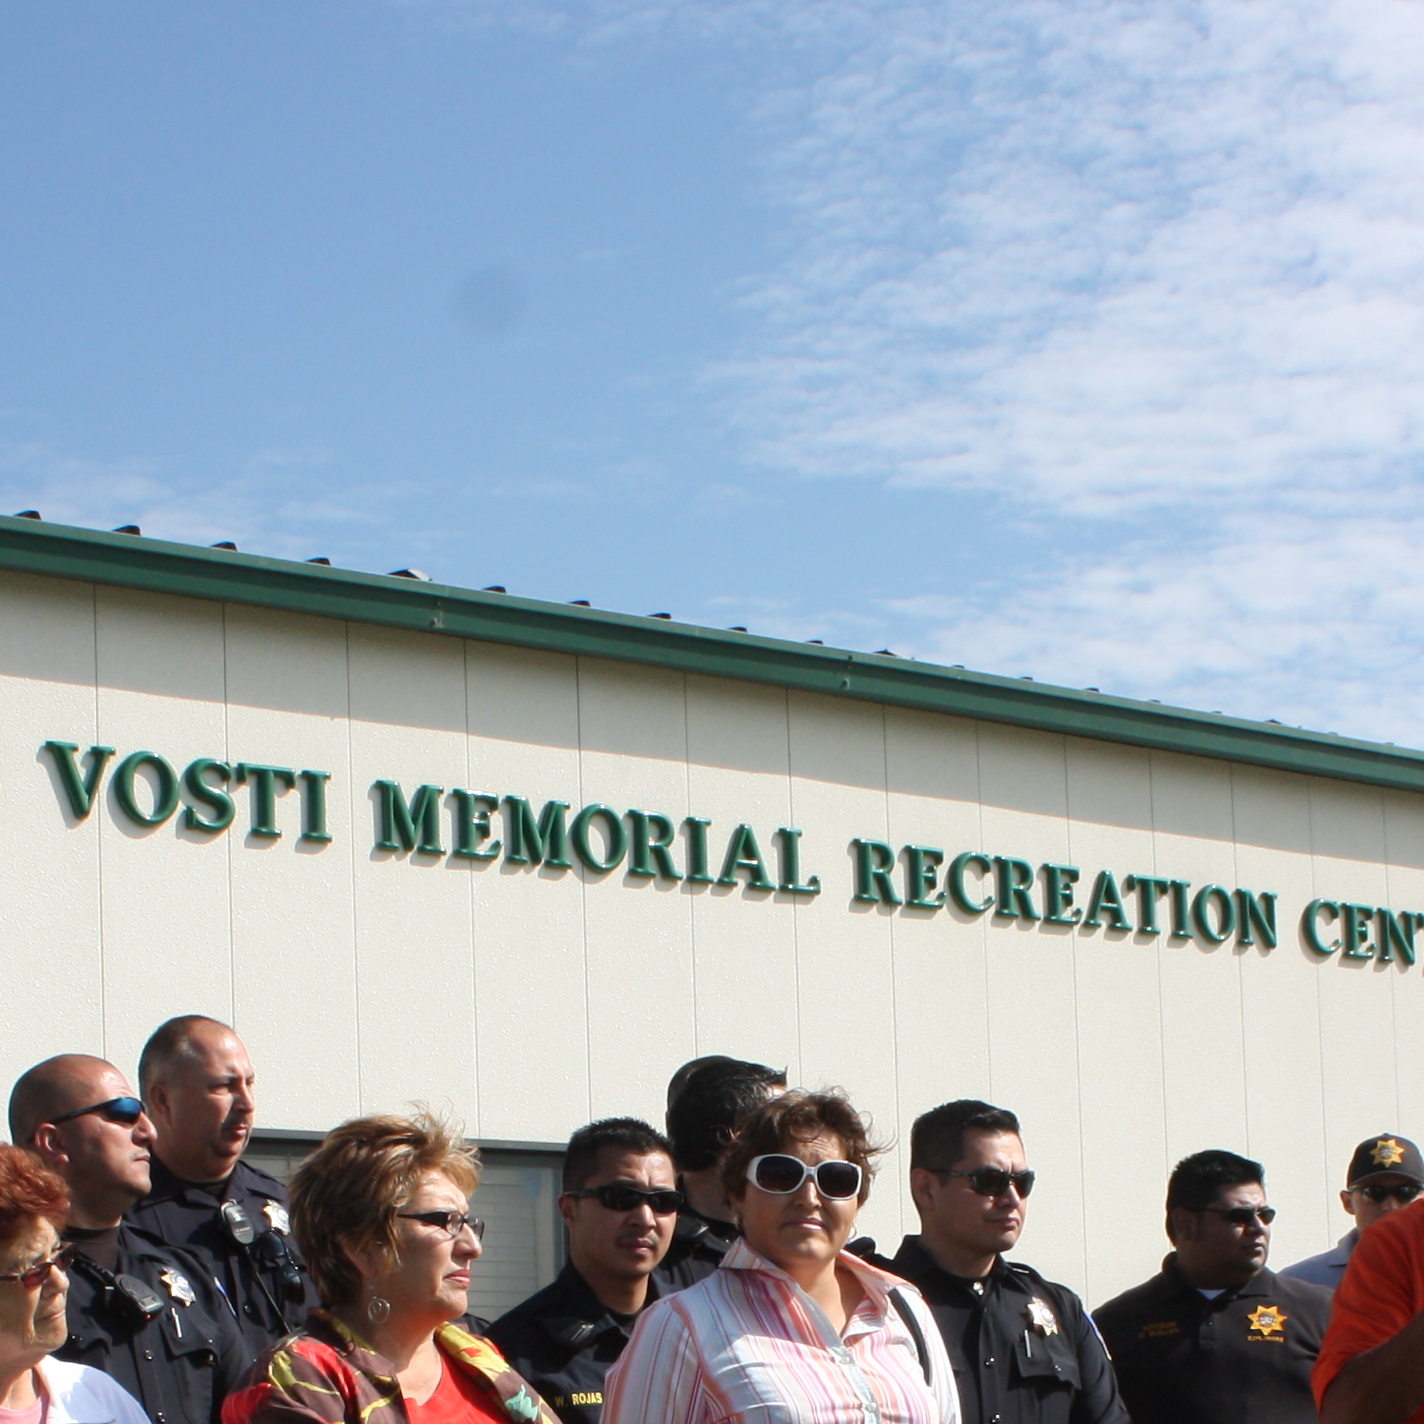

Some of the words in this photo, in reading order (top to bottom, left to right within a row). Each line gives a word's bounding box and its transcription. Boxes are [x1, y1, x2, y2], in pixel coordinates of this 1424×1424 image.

[45, 740, 333, 843] VOSTI
[374, 779, 821, 896] MEMORIAL
[851, 838, 1278, 950] RECREATION
[571, 1392, 603, 1405] ROJAS
